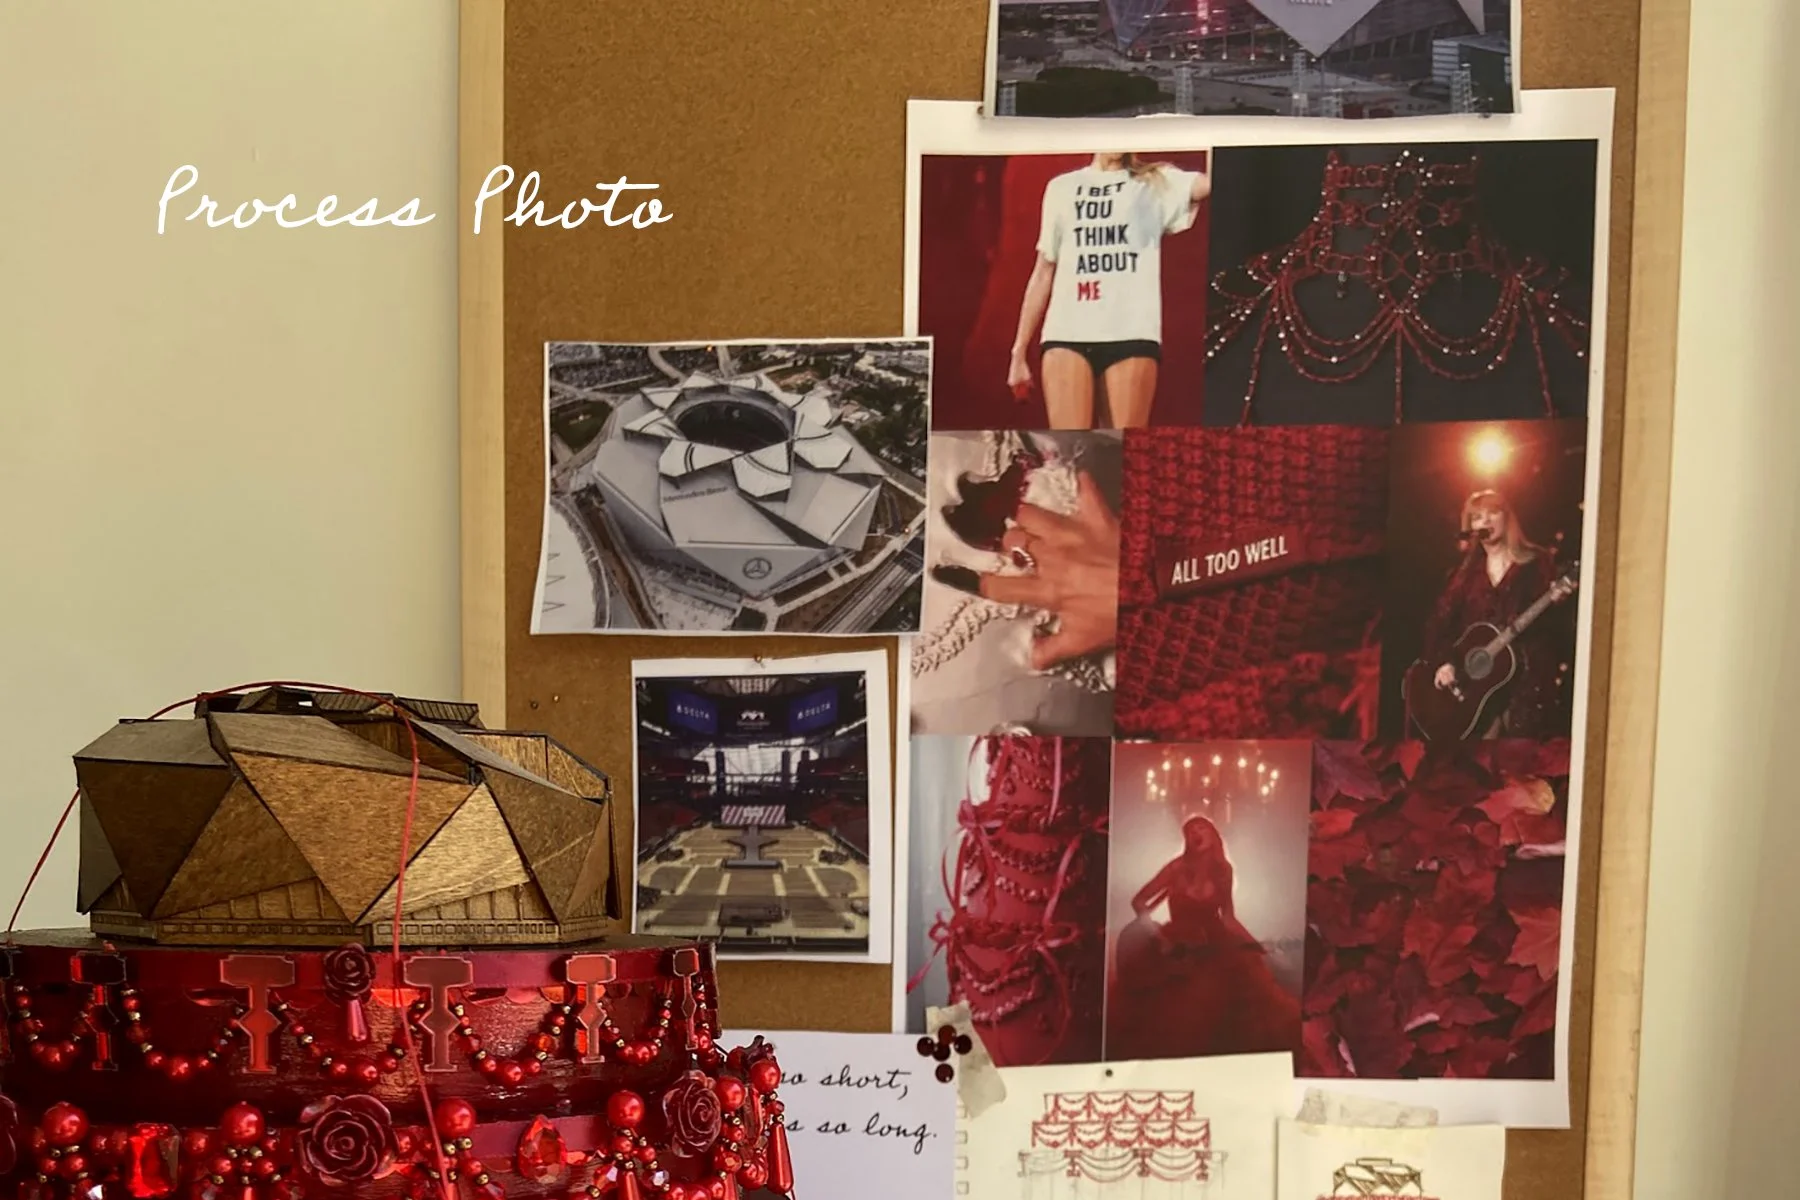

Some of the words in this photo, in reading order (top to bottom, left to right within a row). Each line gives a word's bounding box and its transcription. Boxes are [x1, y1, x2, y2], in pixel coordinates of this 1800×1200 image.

[1076, 185, 1083, 196] I
[1089, 181, 1126, 198] BET
[1075, 199, 1113, 220] YOU
[1074, 224, 1129, 248] THINK
[1076, 252, 1139, 275] ABOUT
[1077, 280, 1102, 302] ME
[1171, 558, 1200, 585] ALL
[1205, 548, 1241, 577] TOO
[1244, 535, 1288, 564] WELL
[820, 1064, 912, 1101] short,
[817, 1121, 851, 1135] so
[864, 1112, 938, 1155] long.
